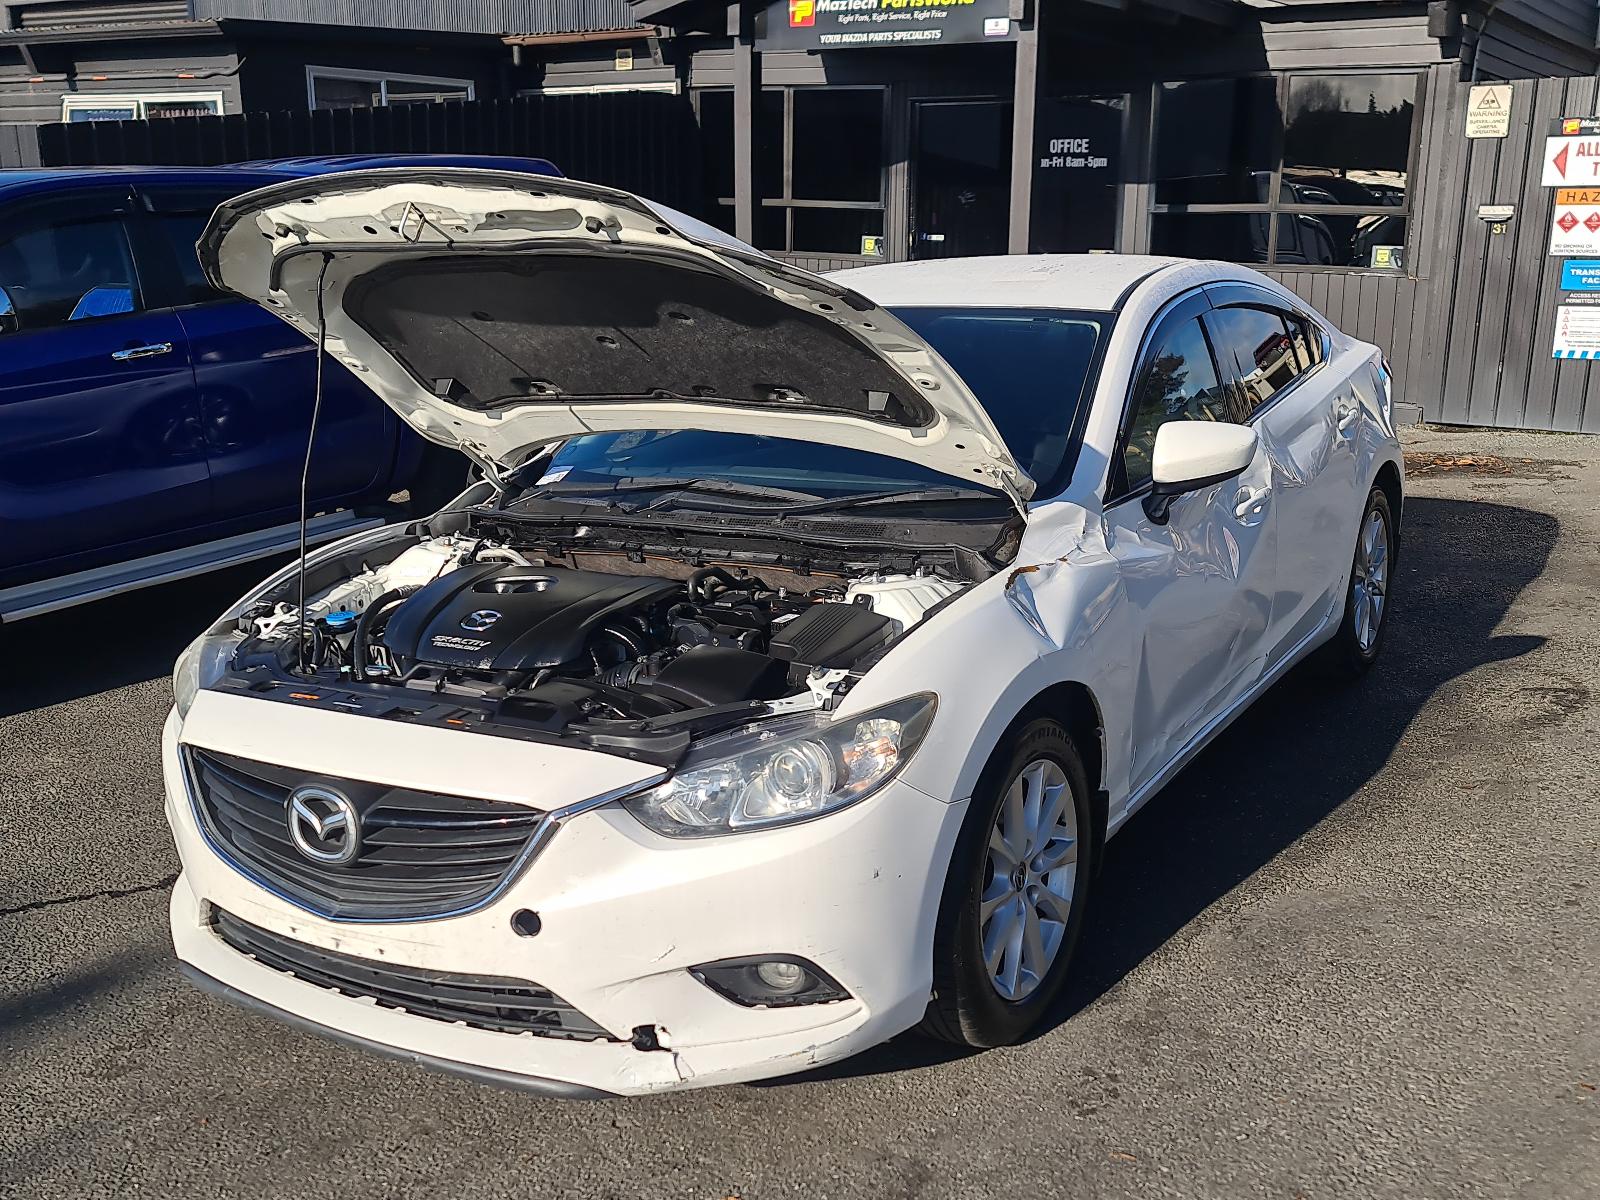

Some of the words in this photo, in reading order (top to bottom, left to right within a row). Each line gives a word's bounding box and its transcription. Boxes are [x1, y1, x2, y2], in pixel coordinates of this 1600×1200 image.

[872, 12, 888, 22] Right
[914, 10, 930, 20] Right
[820, 34, 841, 44] YOUR
[842, 33, 867, 43] MAZDA
[868, 32, 893, 41] PARTS
[893, 30, 942, 41] SPECIALISTS
[1049, 138, 1090, 154] OFFICE
[1065, 155, 1108, 168] 8am-5pm
[1566, 191, 1600, 202] HAZ
[1492, 223, 1507, 234] 31
